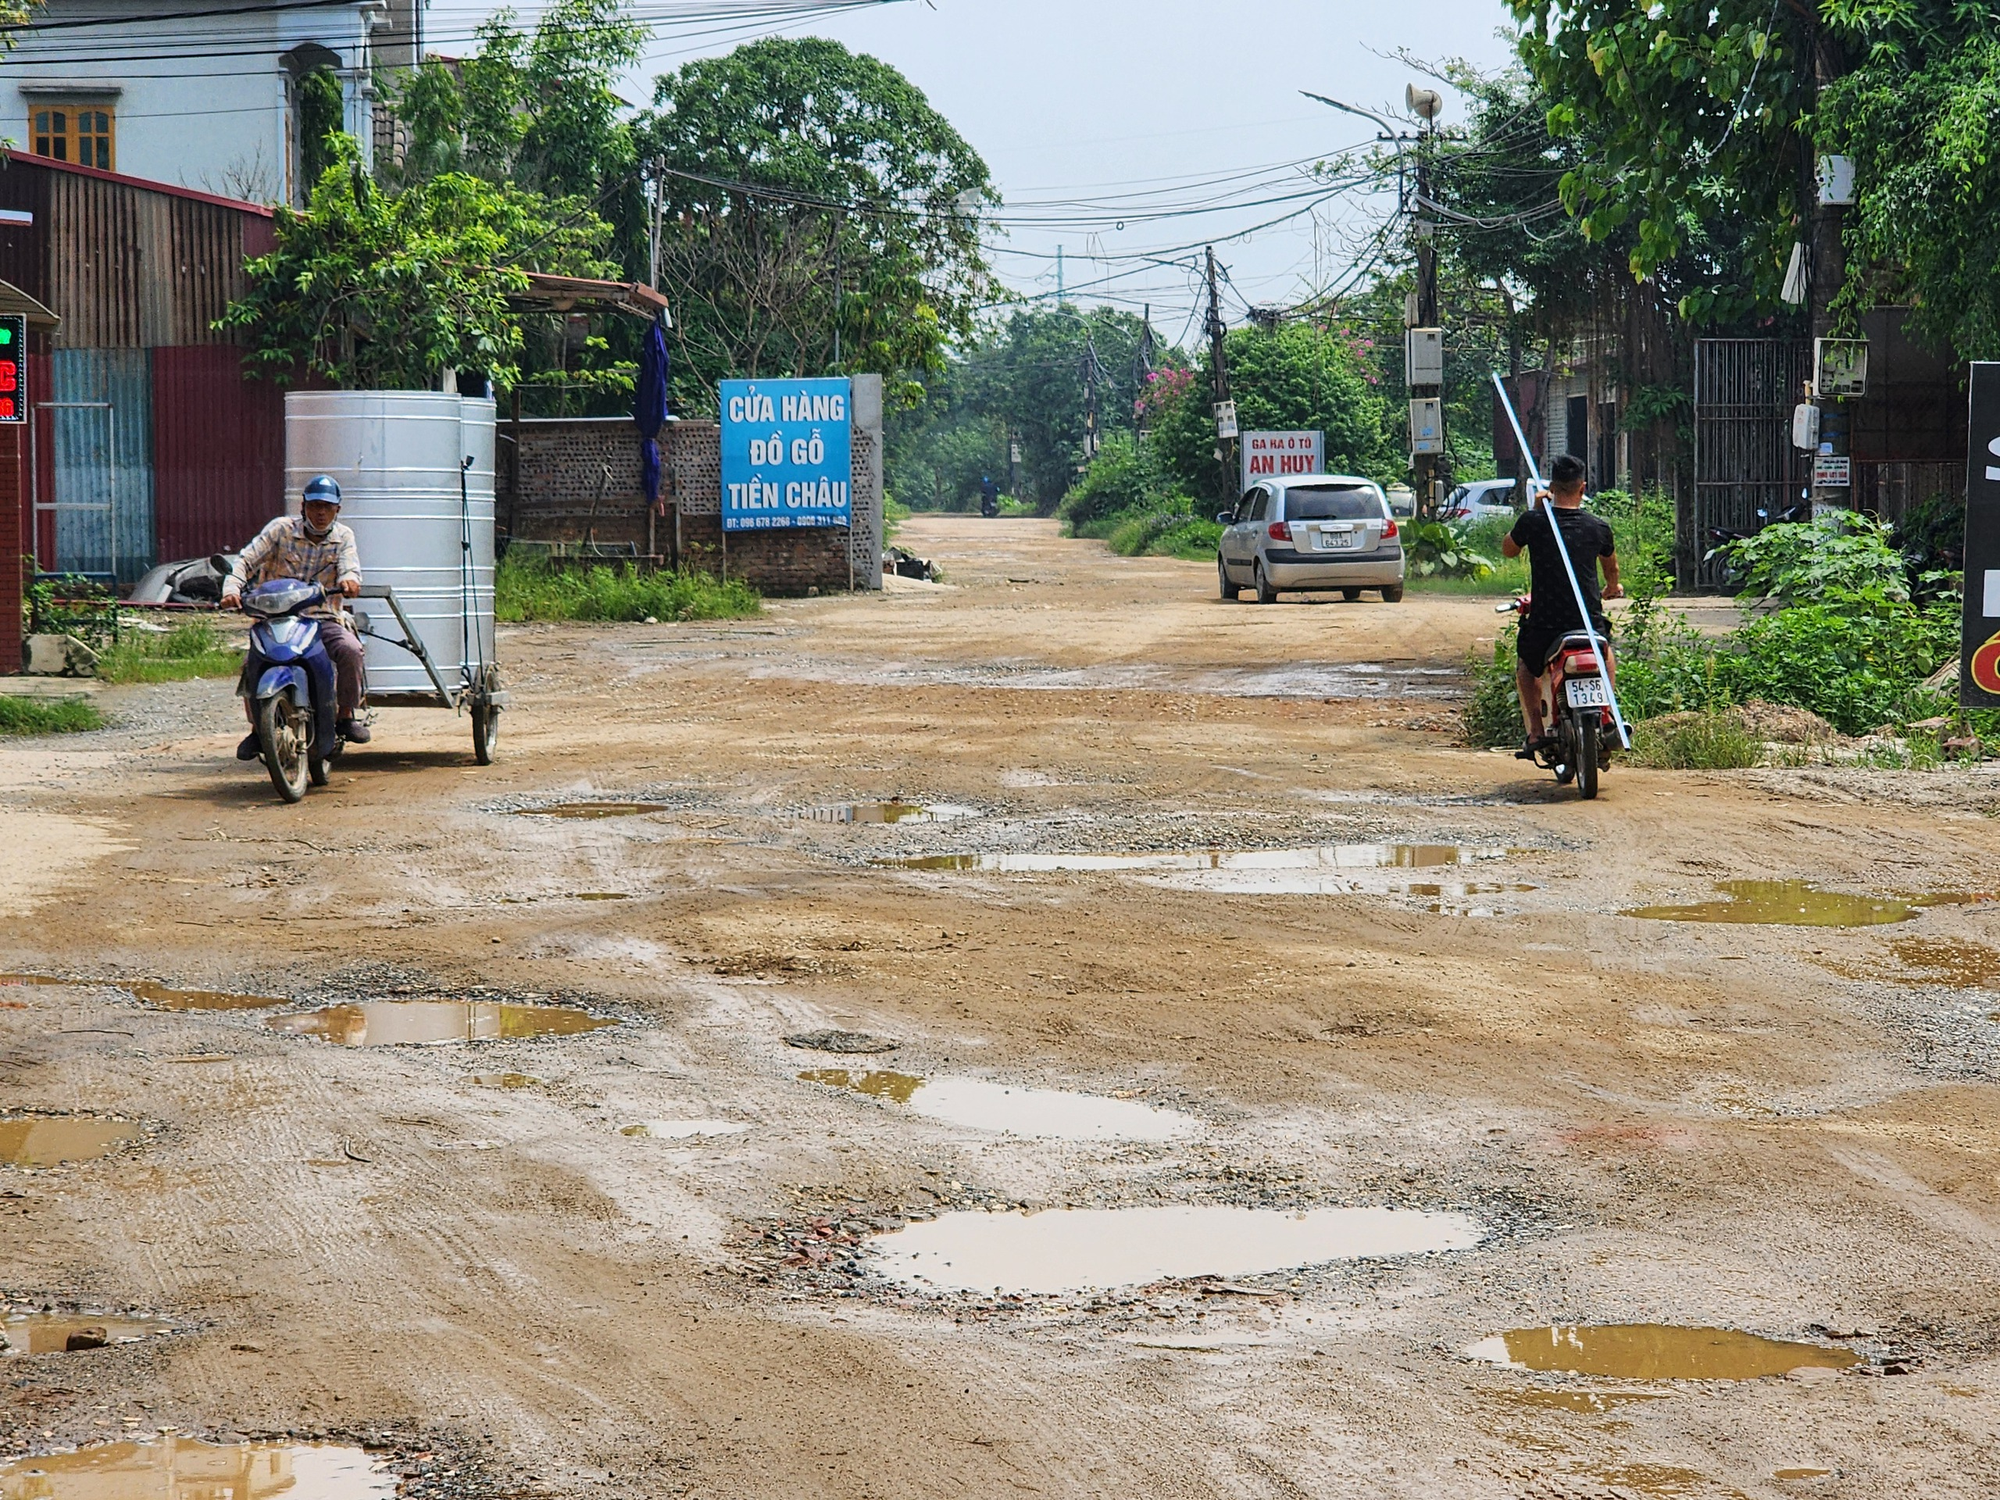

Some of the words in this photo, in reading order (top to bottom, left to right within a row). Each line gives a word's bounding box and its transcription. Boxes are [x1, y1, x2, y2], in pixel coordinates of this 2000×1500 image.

[729, 386, 775, 423] CỬA
[782, 390, 844, 422] HÀNG
[749, 430, 783, 466] ĐỒ
[791, 429, 825, 465] GỖ
[1252, 438, 1266, 449] GA
[1298, 436, 1311, 449] TÔ
[1249, 455, 1274, 474] AN
[1280, 454, 1315, 474] HUY
[728, 474, 778, 510] TIỀN
[786, 476, 847, 509] CHÂU
[1573, 692, 1604, 706] 1349
